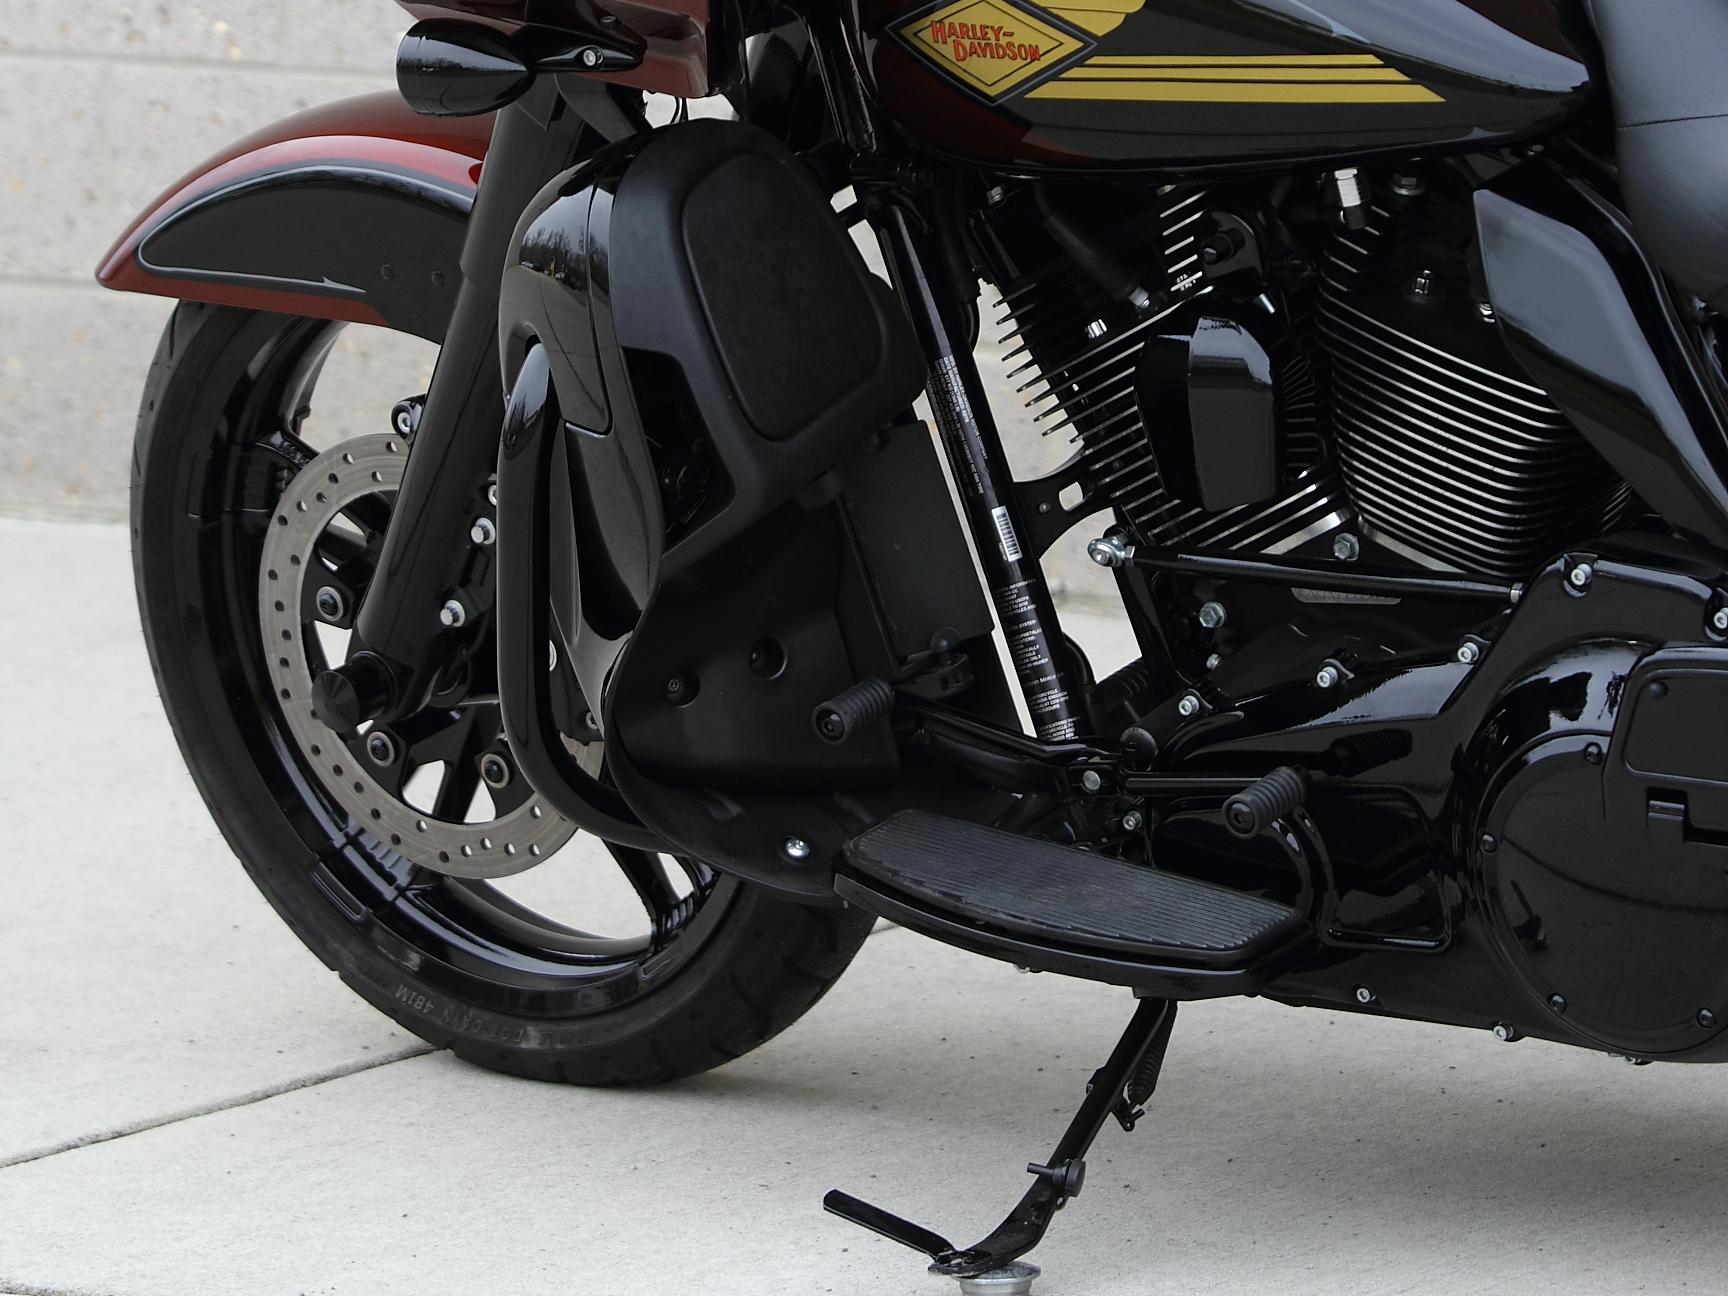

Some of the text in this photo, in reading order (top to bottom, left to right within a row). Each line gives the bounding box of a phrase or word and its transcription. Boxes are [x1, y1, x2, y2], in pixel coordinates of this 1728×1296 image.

[931, 20, 1015, 44] HARLEY-
[953, 41, 1041, 62] DAVIDSON
[393, 984, 436, 1013] 4B1M
